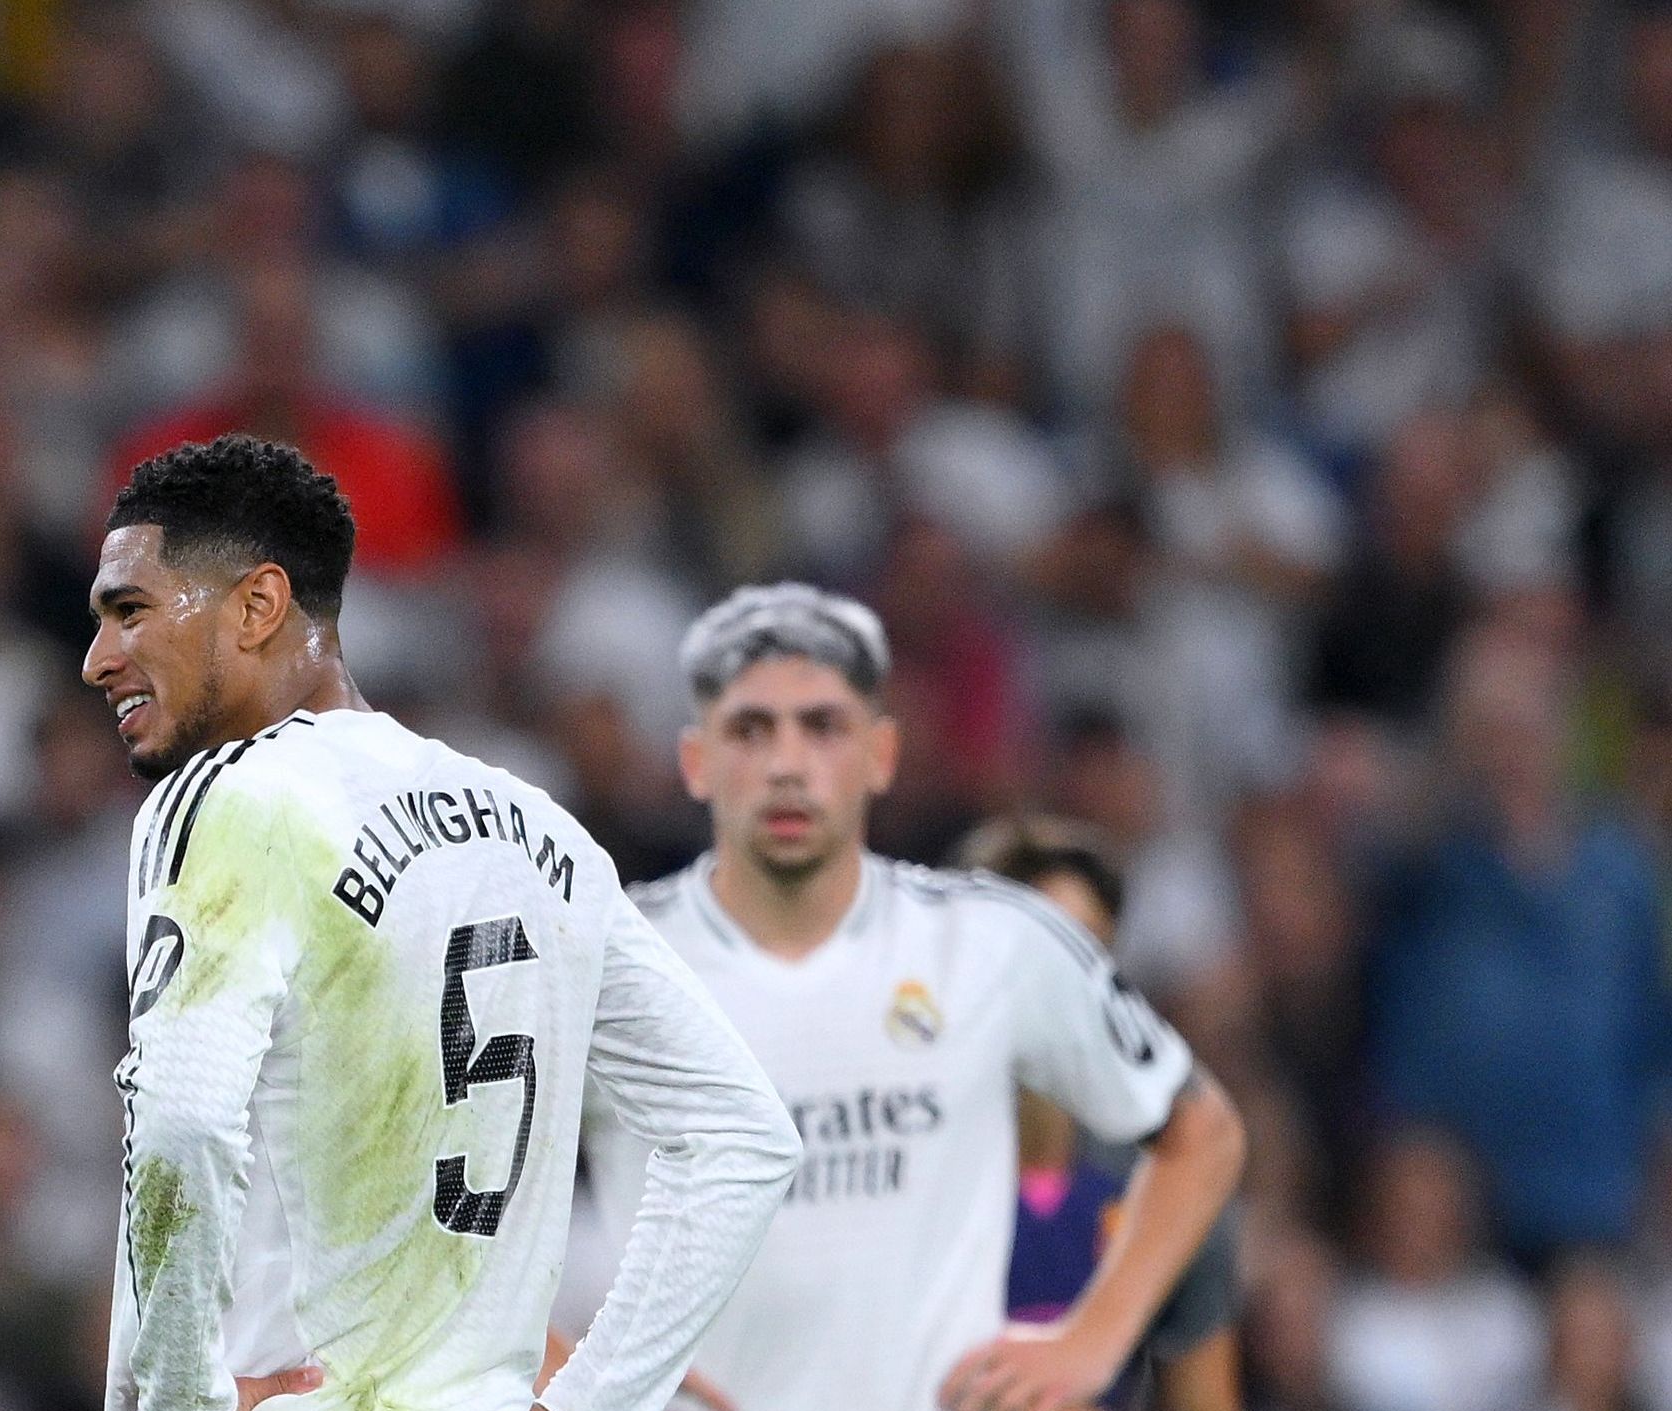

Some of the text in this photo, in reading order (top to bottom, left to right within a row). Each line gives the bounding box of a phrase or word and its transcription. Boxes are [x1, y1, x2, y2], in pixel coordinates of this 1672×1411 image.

[332, 788, 575, 928] BELLINGHAM
[432, 915, 539, 1238] 5
[790, 1088, 943, 1142] rates
